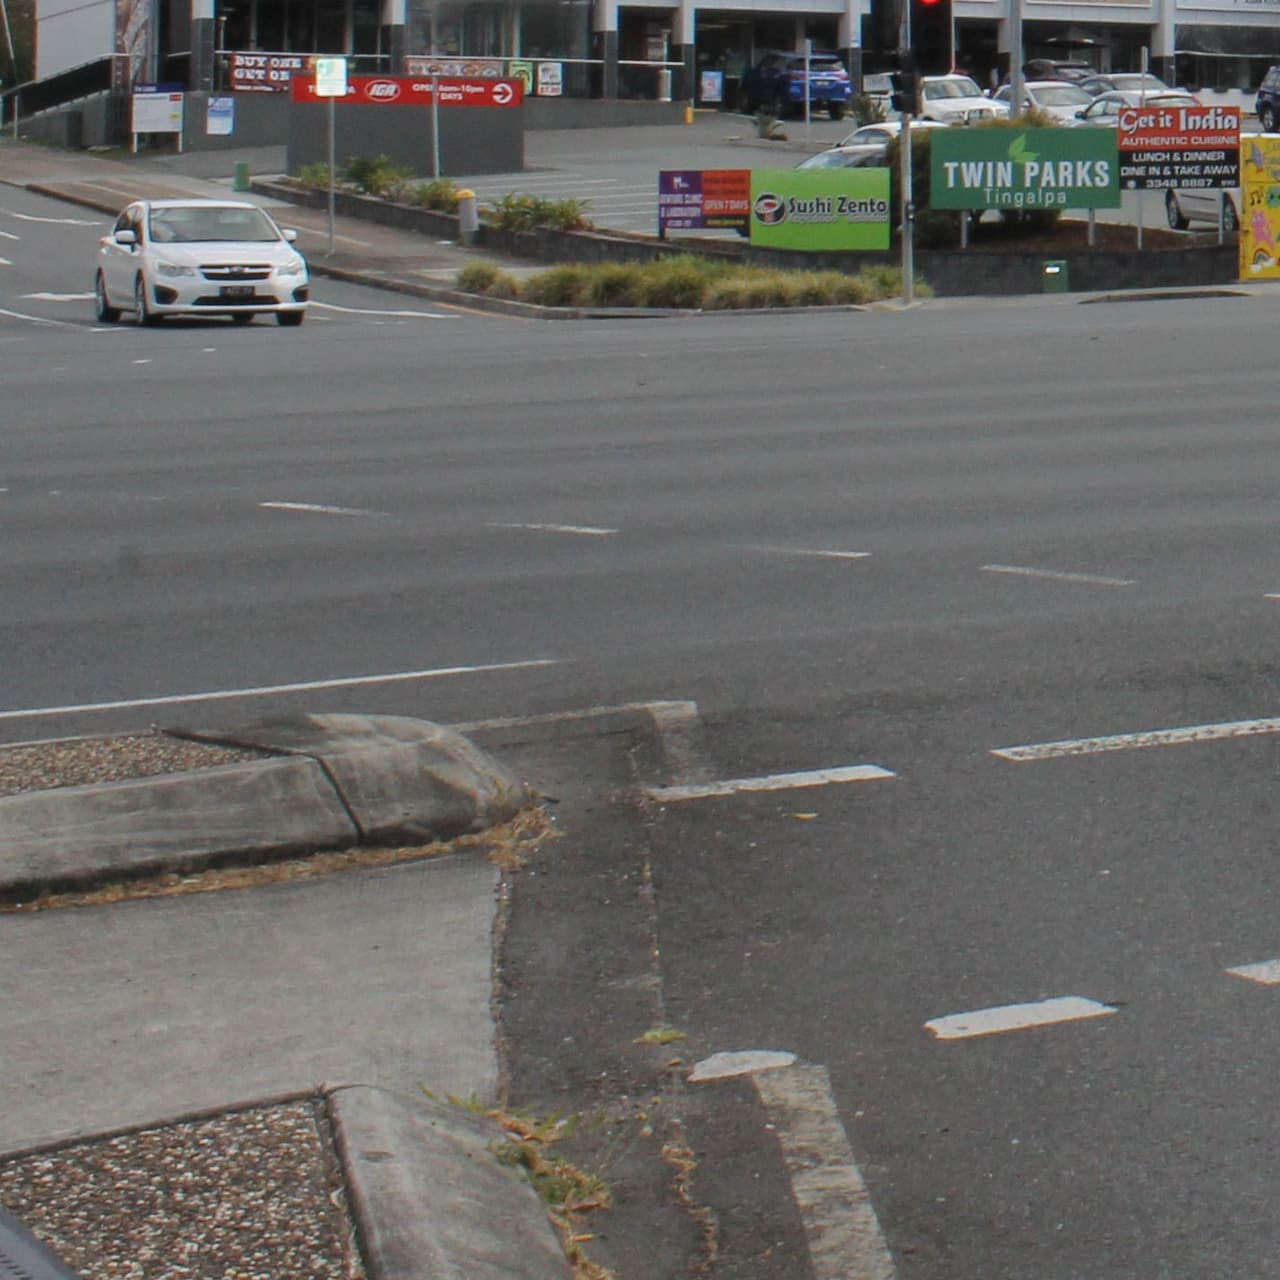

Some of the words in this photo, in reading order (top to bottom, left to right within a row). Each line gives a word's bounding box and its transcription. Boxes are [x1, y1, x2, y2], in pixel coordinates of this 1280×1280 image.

[234, 56, 268, 68] BUY
[270, 56, 302, 69] ONE
[234, 69, 267, 80] GET
[368, 84, 397, 97] IGA
[1120, 110, 1157, 135] Get
[1159, 110, 1173, 128] it
[1179, 107, 1238, 132] India
[1122, 136, 1189, 146] AUTHENTIC
[1191, 136, 1238, 145] CUISINE
[1132, 152, 1170, 162] LUNCH
[1173, 152, 1180, 162] &
[1183, 151, 1226, 161] DINNER
[944, 161, 1012, 188] TWIN
[1024, 160, 1110, 188] PARKS
[1120, 166, 1147, 176] DINE
[1148, 166, 1160, 176] IN
[1163, 166, 1172, 176] &
[1175, 166, 1201, 175] TAKE
[1203, 165, 1238, 175] AWAY
[984, 189, 1067, 207] Tingalpa
[789, 196, 831, 214] Sushi
[838, 196, 887, 214] Zento
